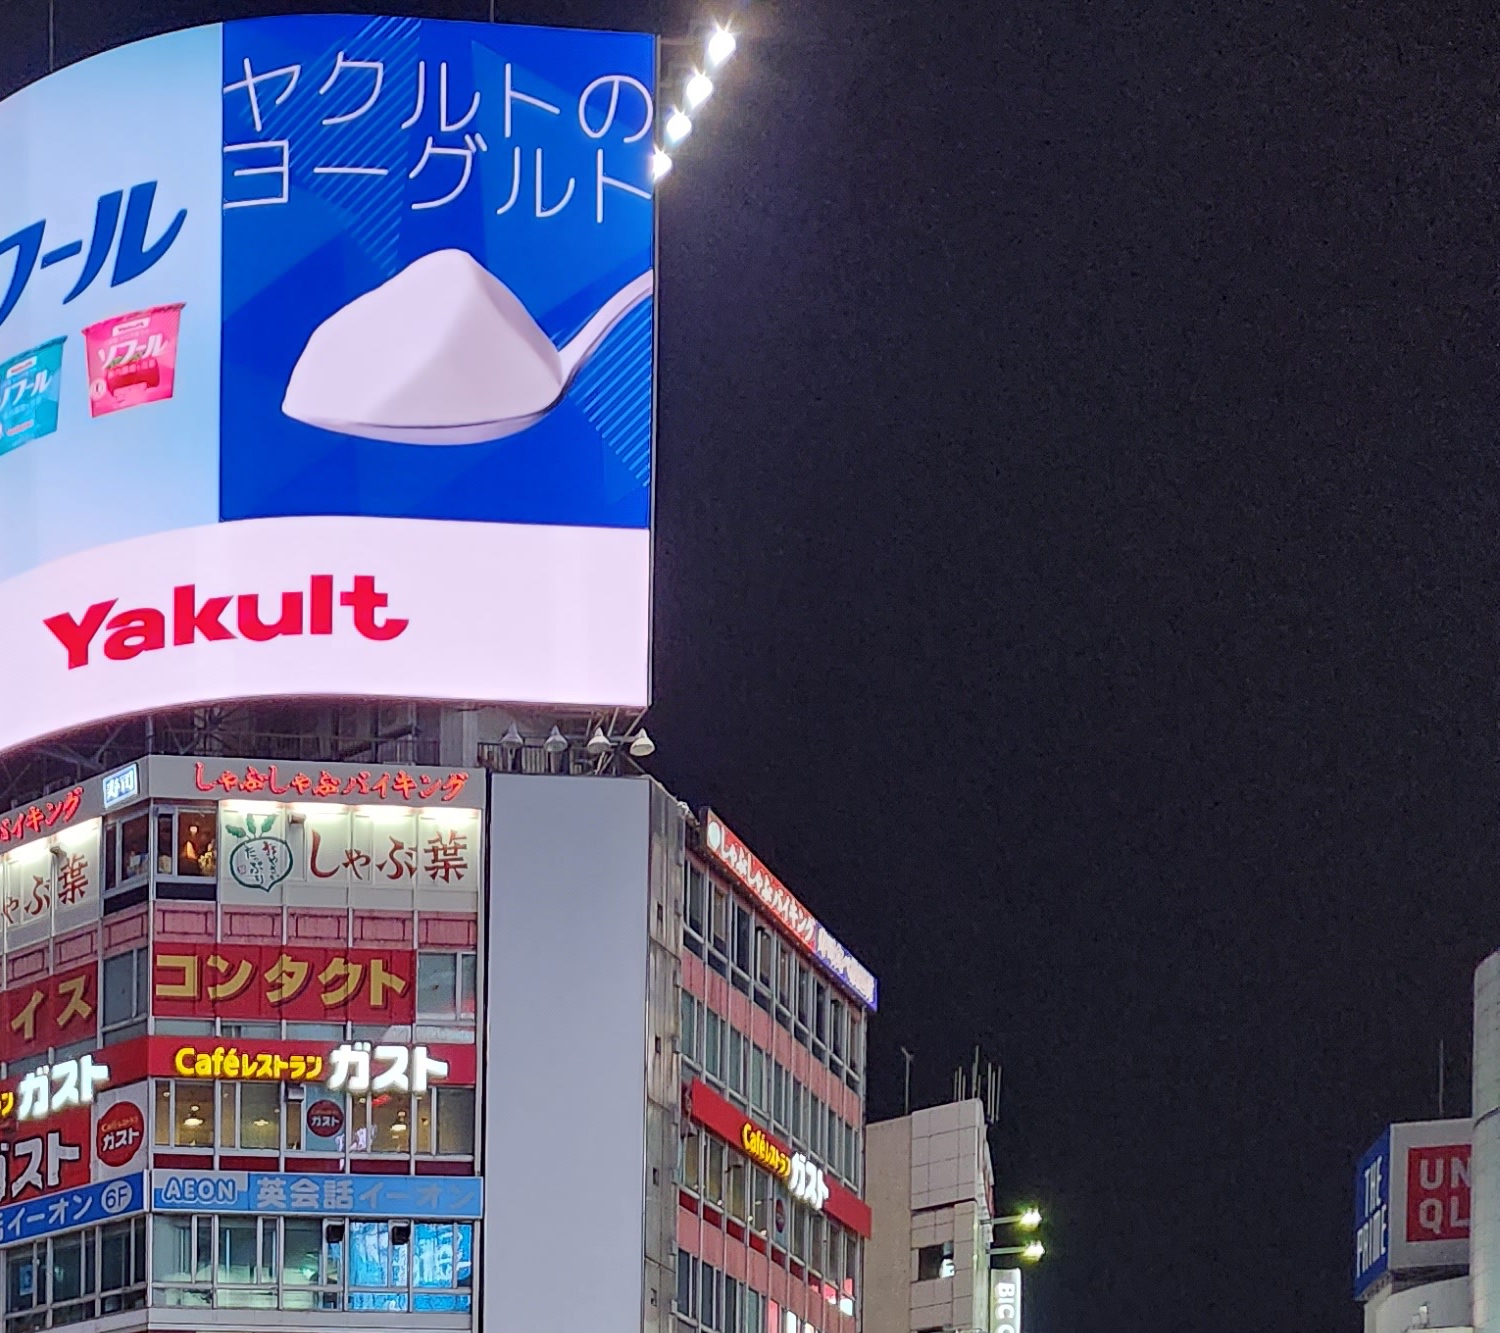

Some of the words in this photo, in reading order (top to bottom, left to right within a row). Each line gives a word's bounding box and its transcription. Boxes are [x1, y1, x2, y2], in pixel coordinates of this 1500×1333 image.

[223, 51, 653, 141] ヤクルトの
[223, 139, 652, 223] ヨーグルト
[98, 333, 169, 369] ソフール
[43, 575, 409, 670] Yakult
[106, 768, 137, 800] 寿司
[194, 761, 470, 802] しゃぶしゃぶバイキング
[309, 828, 469, 884] しゃぶ葉
[155, 953, 408, 1008] コンタクト
[17, 1054, 109, 1120] ガスト
[328, 1041, 449, 1092] ガスト
[102, 1127, 140, 1152] ガスト
[165, 1177, 237, 1203] AEON
[256, 1177, 475, 1211] 英会話イーオン
[788, 1151, 829, 1210] ガスト
[1364, 1155, 1383, 1219] THE
[1419, 1157, 1472, 1190] UN
[105, 1185, 129, 1209] 6F
[1418, 1196, 1471, 1235] QL
[995, 1281, 1016, 1319] BIC
